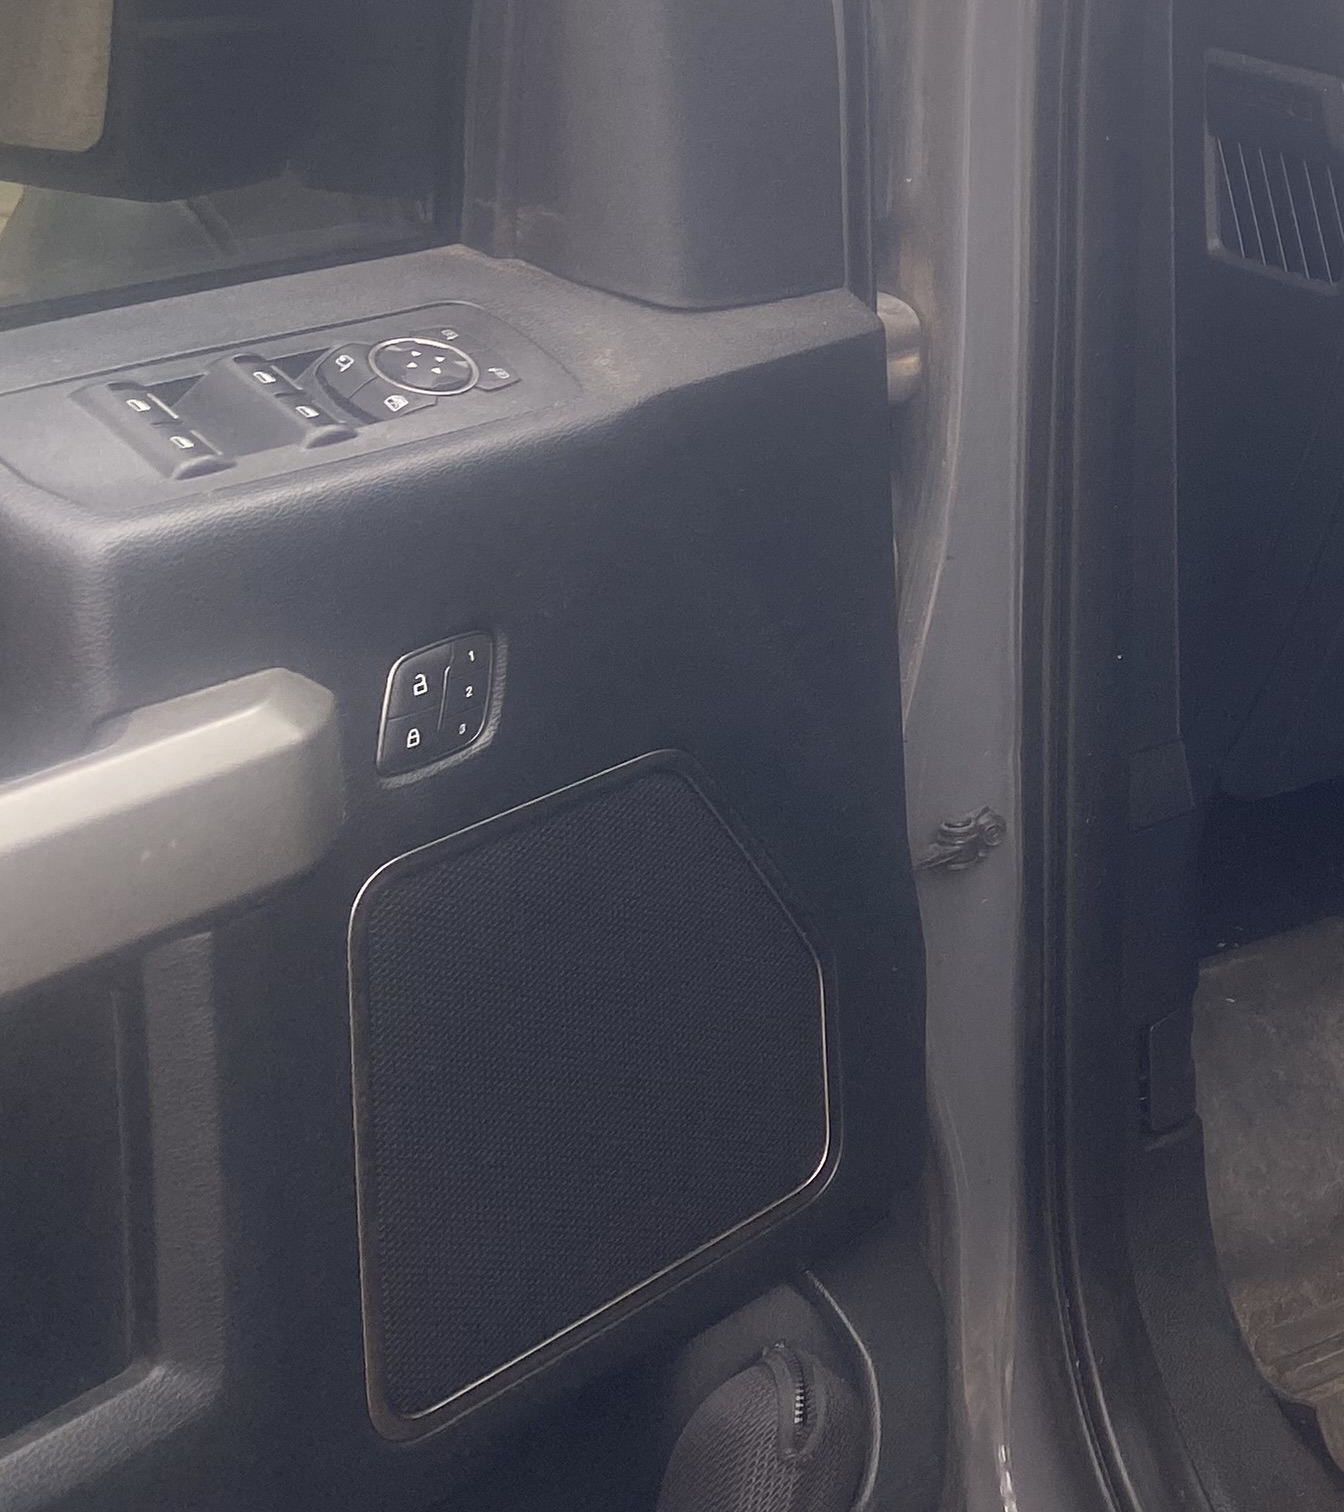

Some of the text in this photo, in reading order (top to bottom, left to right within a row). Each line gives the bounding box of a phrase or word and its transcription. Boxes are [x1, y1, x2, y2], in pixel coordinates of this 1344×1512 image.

[468, 650, 475, 662] 1
[465, 685, 473, 698] 2
[459, 723, 466, 735] 3
